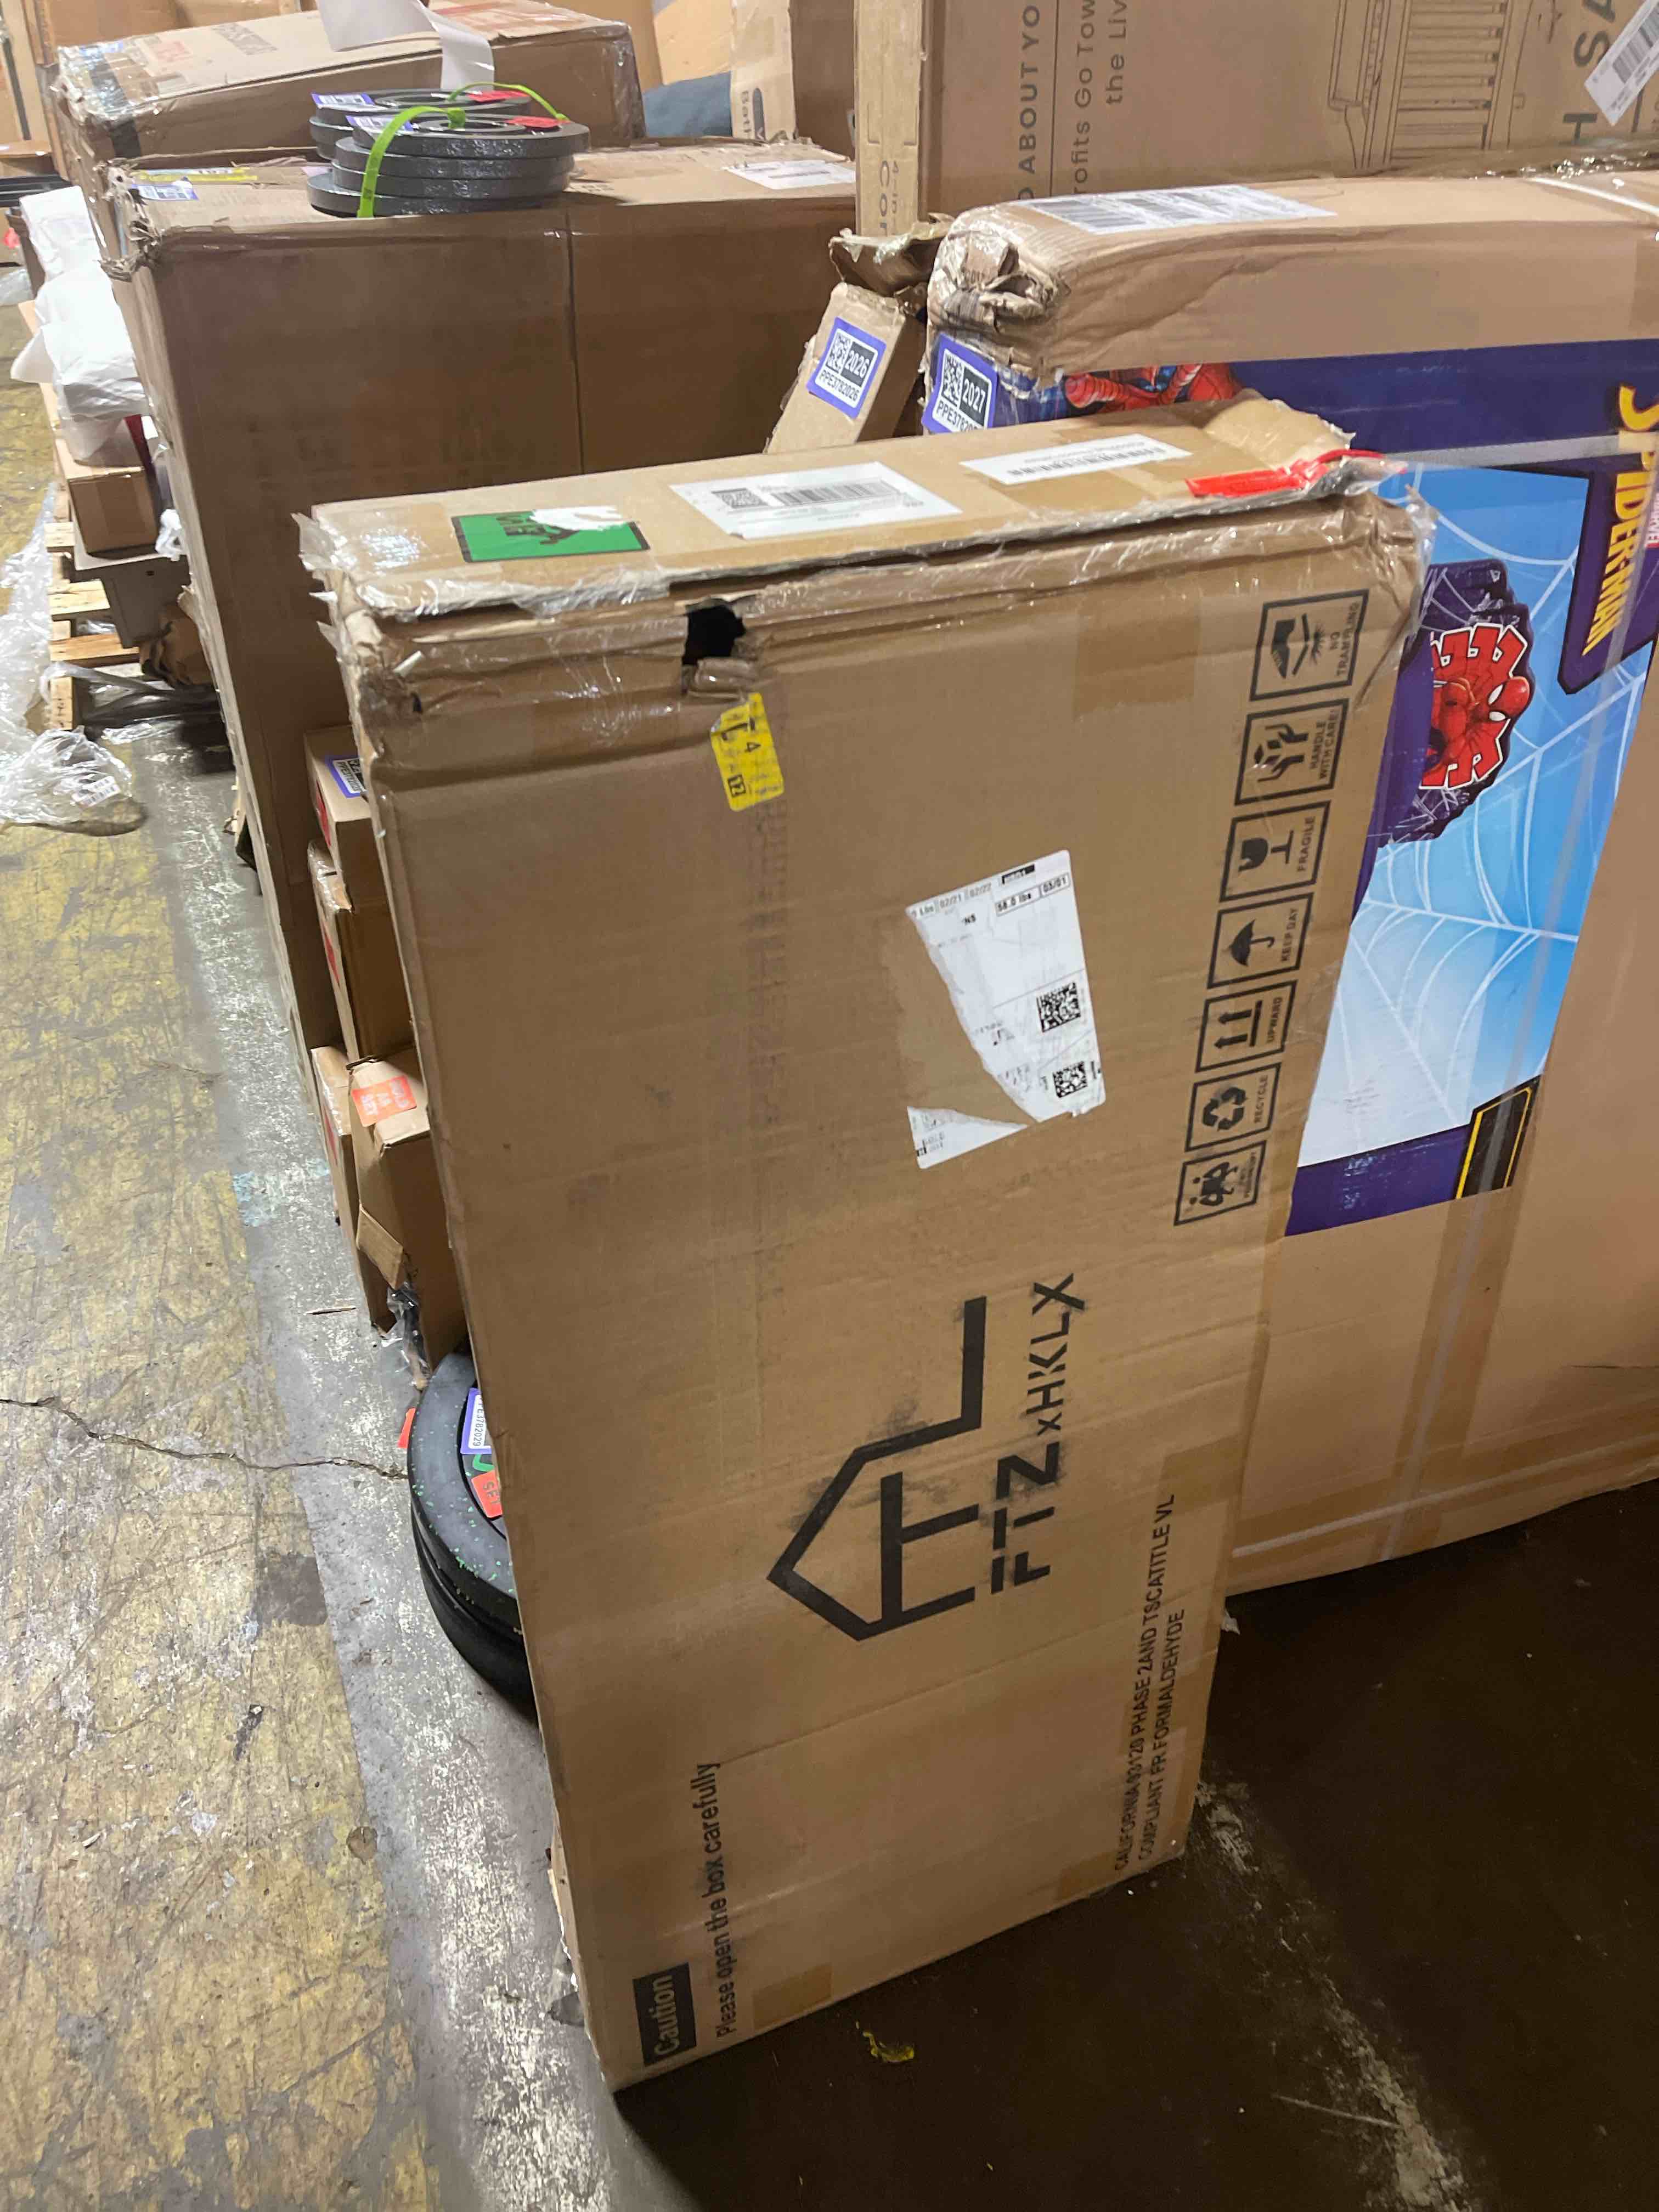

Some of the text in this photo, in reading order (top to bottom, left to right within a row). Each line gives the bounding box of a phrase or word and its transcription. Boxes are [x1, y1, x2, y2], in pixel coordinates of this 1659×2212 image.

[1075, 67, 1093, 109] Go
[1105, 54, 1125, 105] the
[1018, 62, 1039, 174] ABOUT
[820, 369, 860, 402] PPE3782026
[845, 349, 870, 379] 2026
[962, 378, 986, 413] 2027
[1310, 721, 1326, 770] HANDLE
[1297, 816, 1316, 872] FRAGILE
[1267, 996, 1283, 1043] UPWARD
[1254, 1074, 1269, 1124] RECYCLE
[1138, 1623, 1158, 1678] 2AND
[1130, 1677, 1152, 1741] PHASE
[1138, 1776, 1164, 1862] COMPLIANT
[1153, 1609, 1185, 1750] FORMALDEHYDE
[690, 1763, 738, 2039] Please open the box carefully
[650, 1974, 680, 2056] Caution
